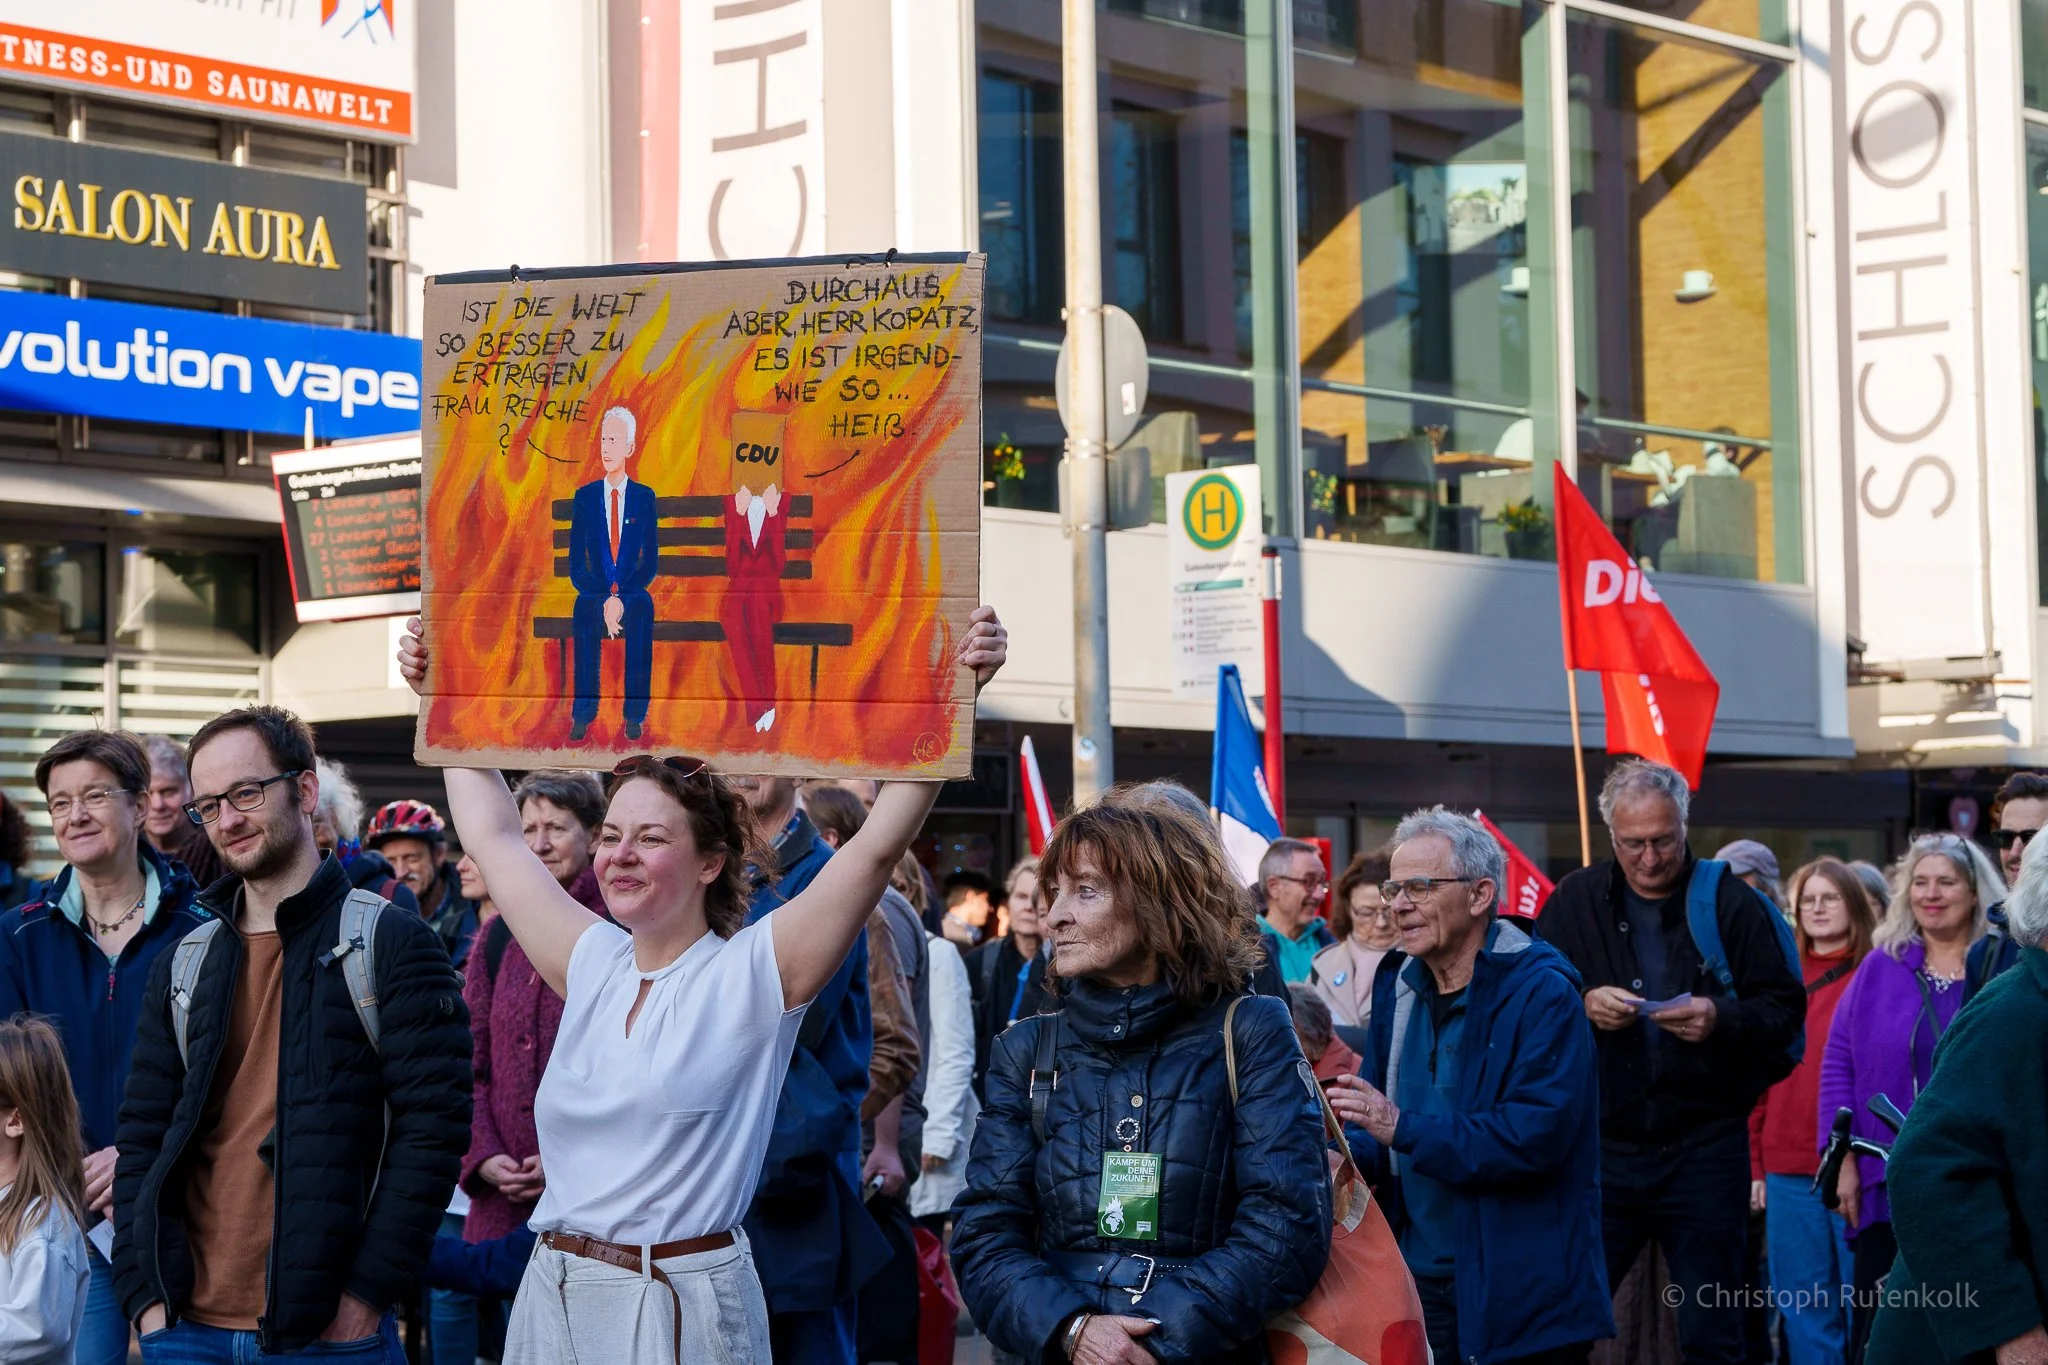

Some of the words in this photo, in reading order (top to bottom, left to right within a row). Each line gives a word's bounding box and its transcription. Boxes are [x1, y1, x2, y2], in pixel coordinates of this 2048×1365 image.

[206, 69, 393, 124] SAUNAWELT
[14, 174, 194, 252] SALON
[202, 201, 341, 270] AURA
[461, 300, 498, 324] IST
[513, 296, 555, 321] DIE
[571, 292, 646, 321] WELT
[800, 309, 868, 337] HERR
[435, 332, 467, 358] SO
[476, 328, 583, 359] BESSER
[590, 331, 625, 353] ZU
[754, 347, 790, 372] ES
[801, 344, 848, 369] IST
[855, 343, 962, 370] IRGEND-
[263, 357, 420, 418] vape
[774, 379, 823, 403] WIE
[430, 393, 492, 421] FRAU
[504, 394, 590, 423] REICHE
[735, 442, 779, 467] CDU
[1201, 491, 1226, 533] H
[1111, 1174, 1155, 1183] ZUKUNFT!
[1128, 1167, 1155, 1175] DEINE
